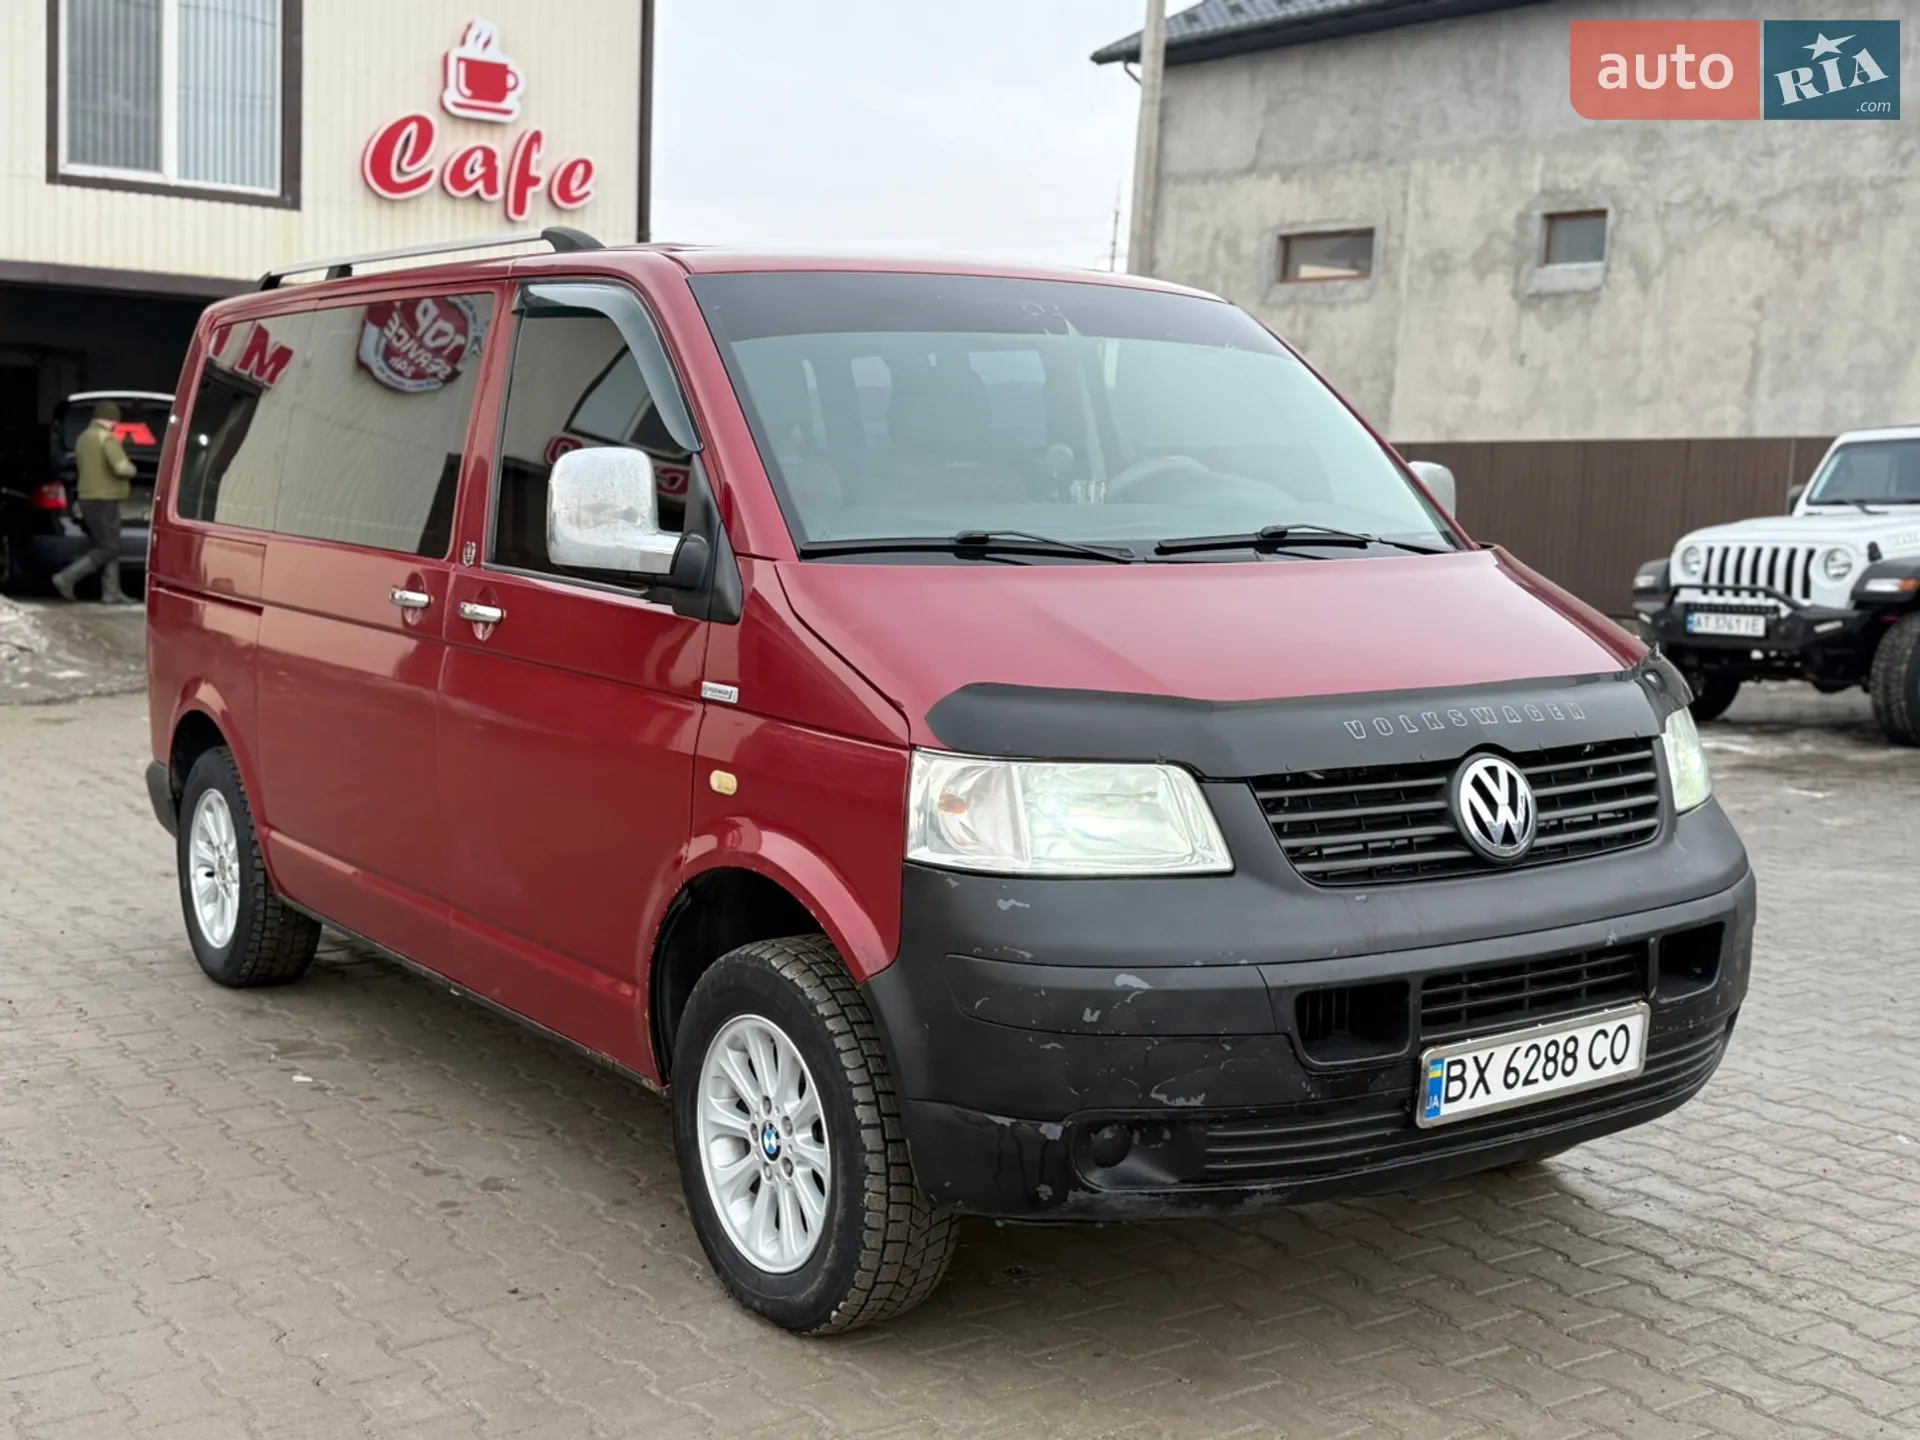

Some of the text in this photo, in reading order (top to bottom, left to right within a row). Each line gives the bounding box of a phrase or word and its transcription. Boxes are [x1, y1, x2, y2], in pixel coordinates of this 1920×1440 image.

[362, 111, 597, 222] Cafe
[1343, 702, 1586, 740] VOLKSWAGEN
[1443, 1023, 1631, 1104] BX 6288 CO
